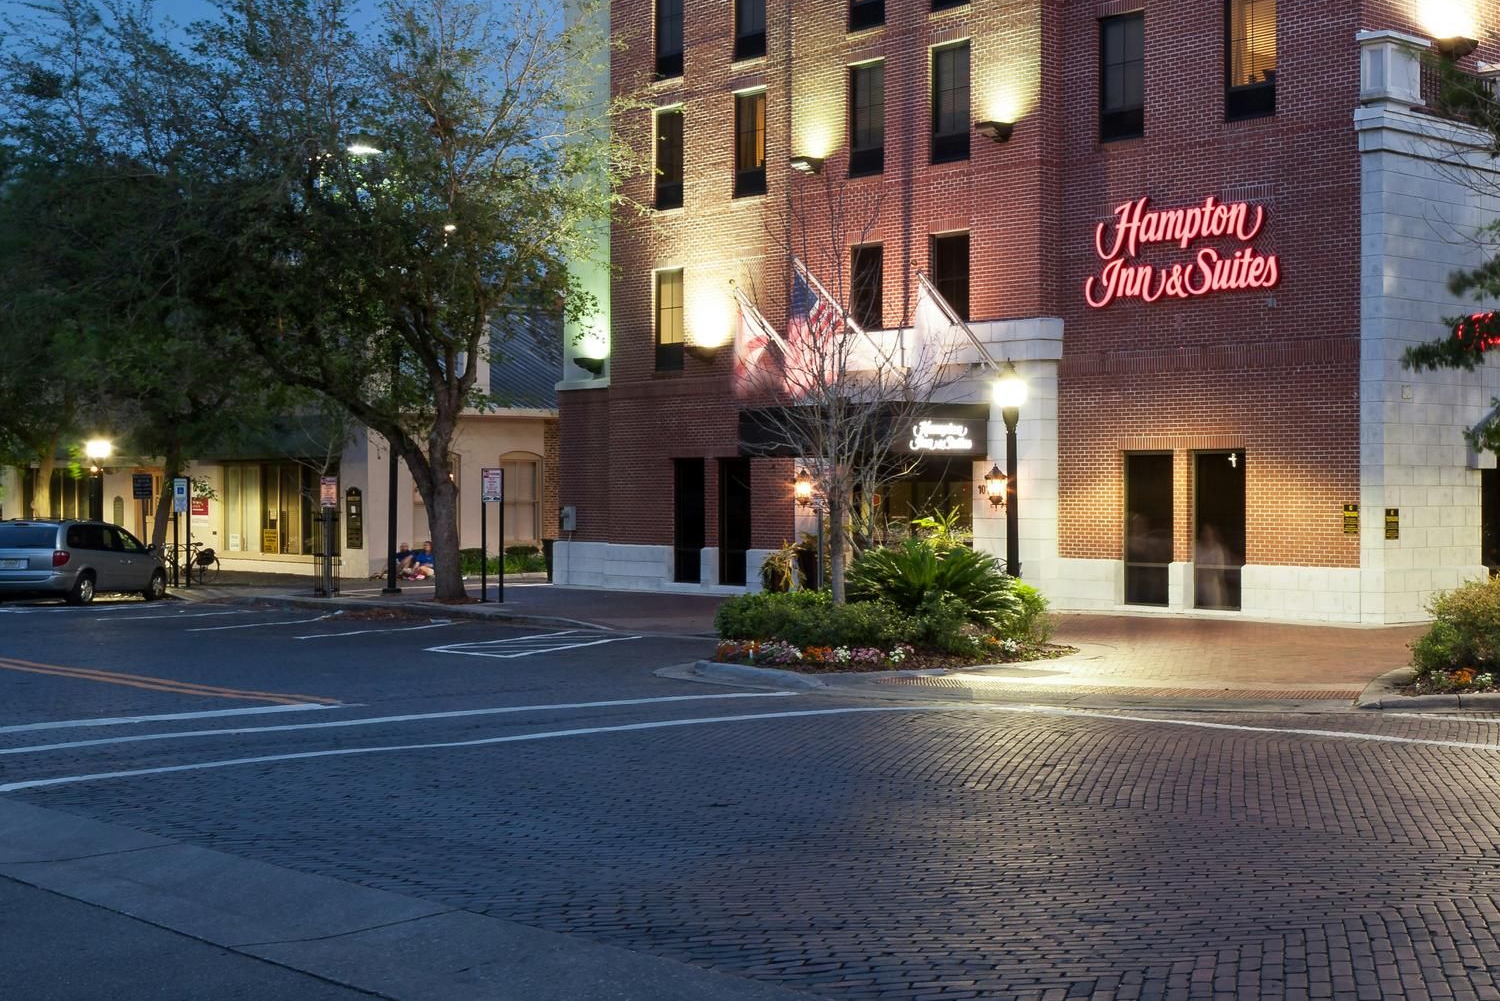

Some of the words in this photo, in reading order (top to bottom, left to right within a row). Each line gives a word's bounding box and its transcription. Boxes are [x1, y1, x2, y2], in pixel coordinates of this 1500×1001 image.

[1096, 197, 1262, 259] Hampton
[1086, 258, 1166, 307] Inn
[1165, 264, 1188, 297] &
[1184, 248, 1277, 296] Suites
